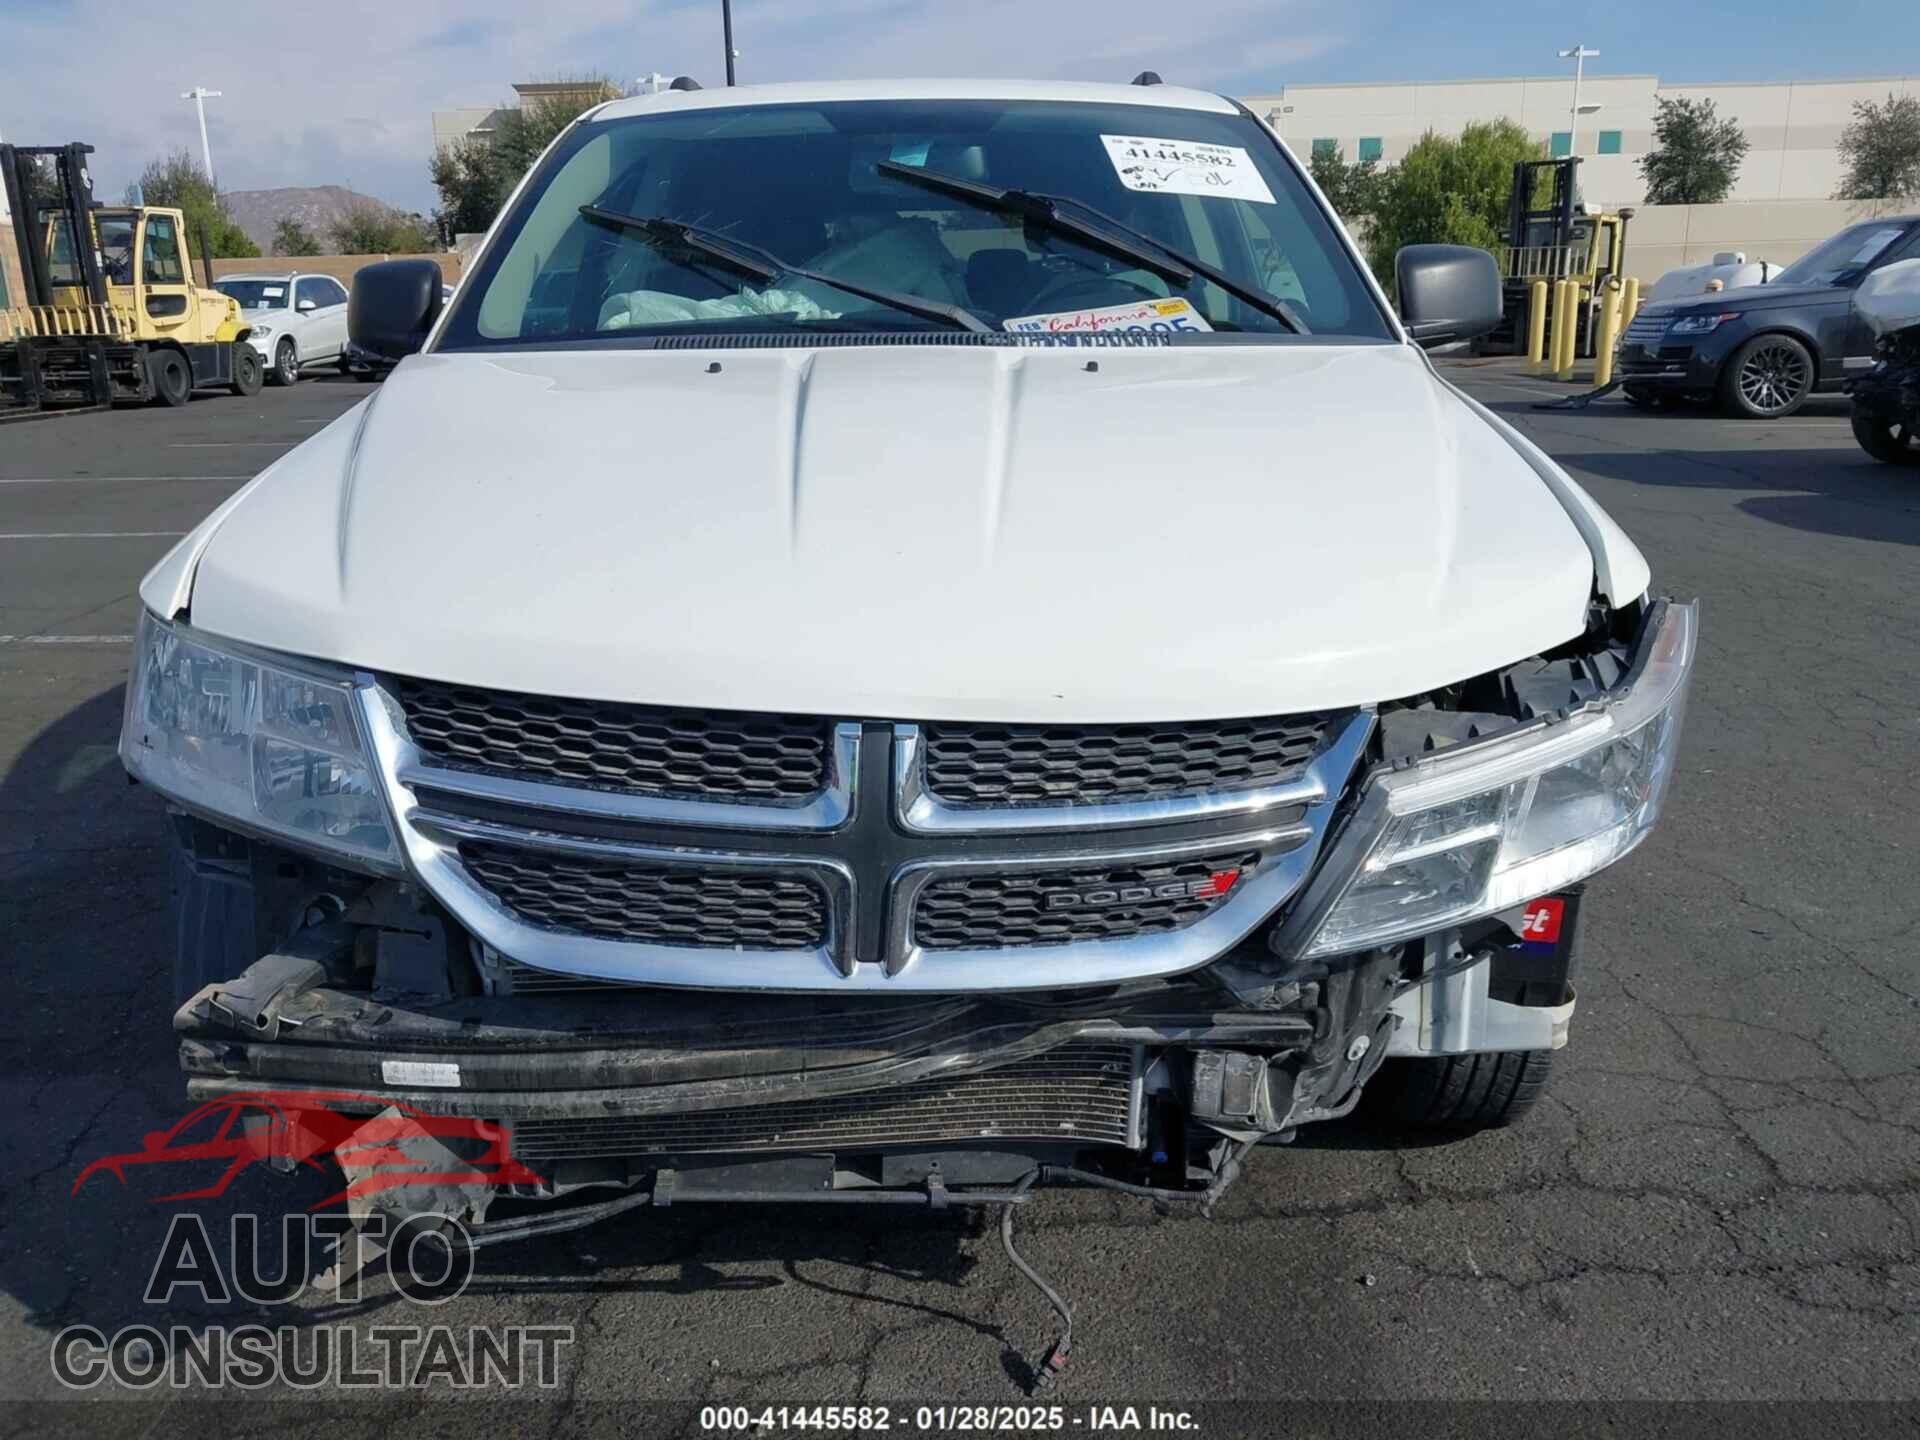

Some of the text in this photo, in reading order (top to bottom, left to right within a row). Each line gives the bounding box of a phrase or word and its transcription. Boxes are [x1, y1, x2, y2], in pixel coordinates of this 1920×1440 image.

[1126, 148, 1237, 168] 41445582
[1017, 322, 1042, 332] FEB
[1049, 311, 1149, 332] California
[1047, 878, 1217, 909] DODGE
